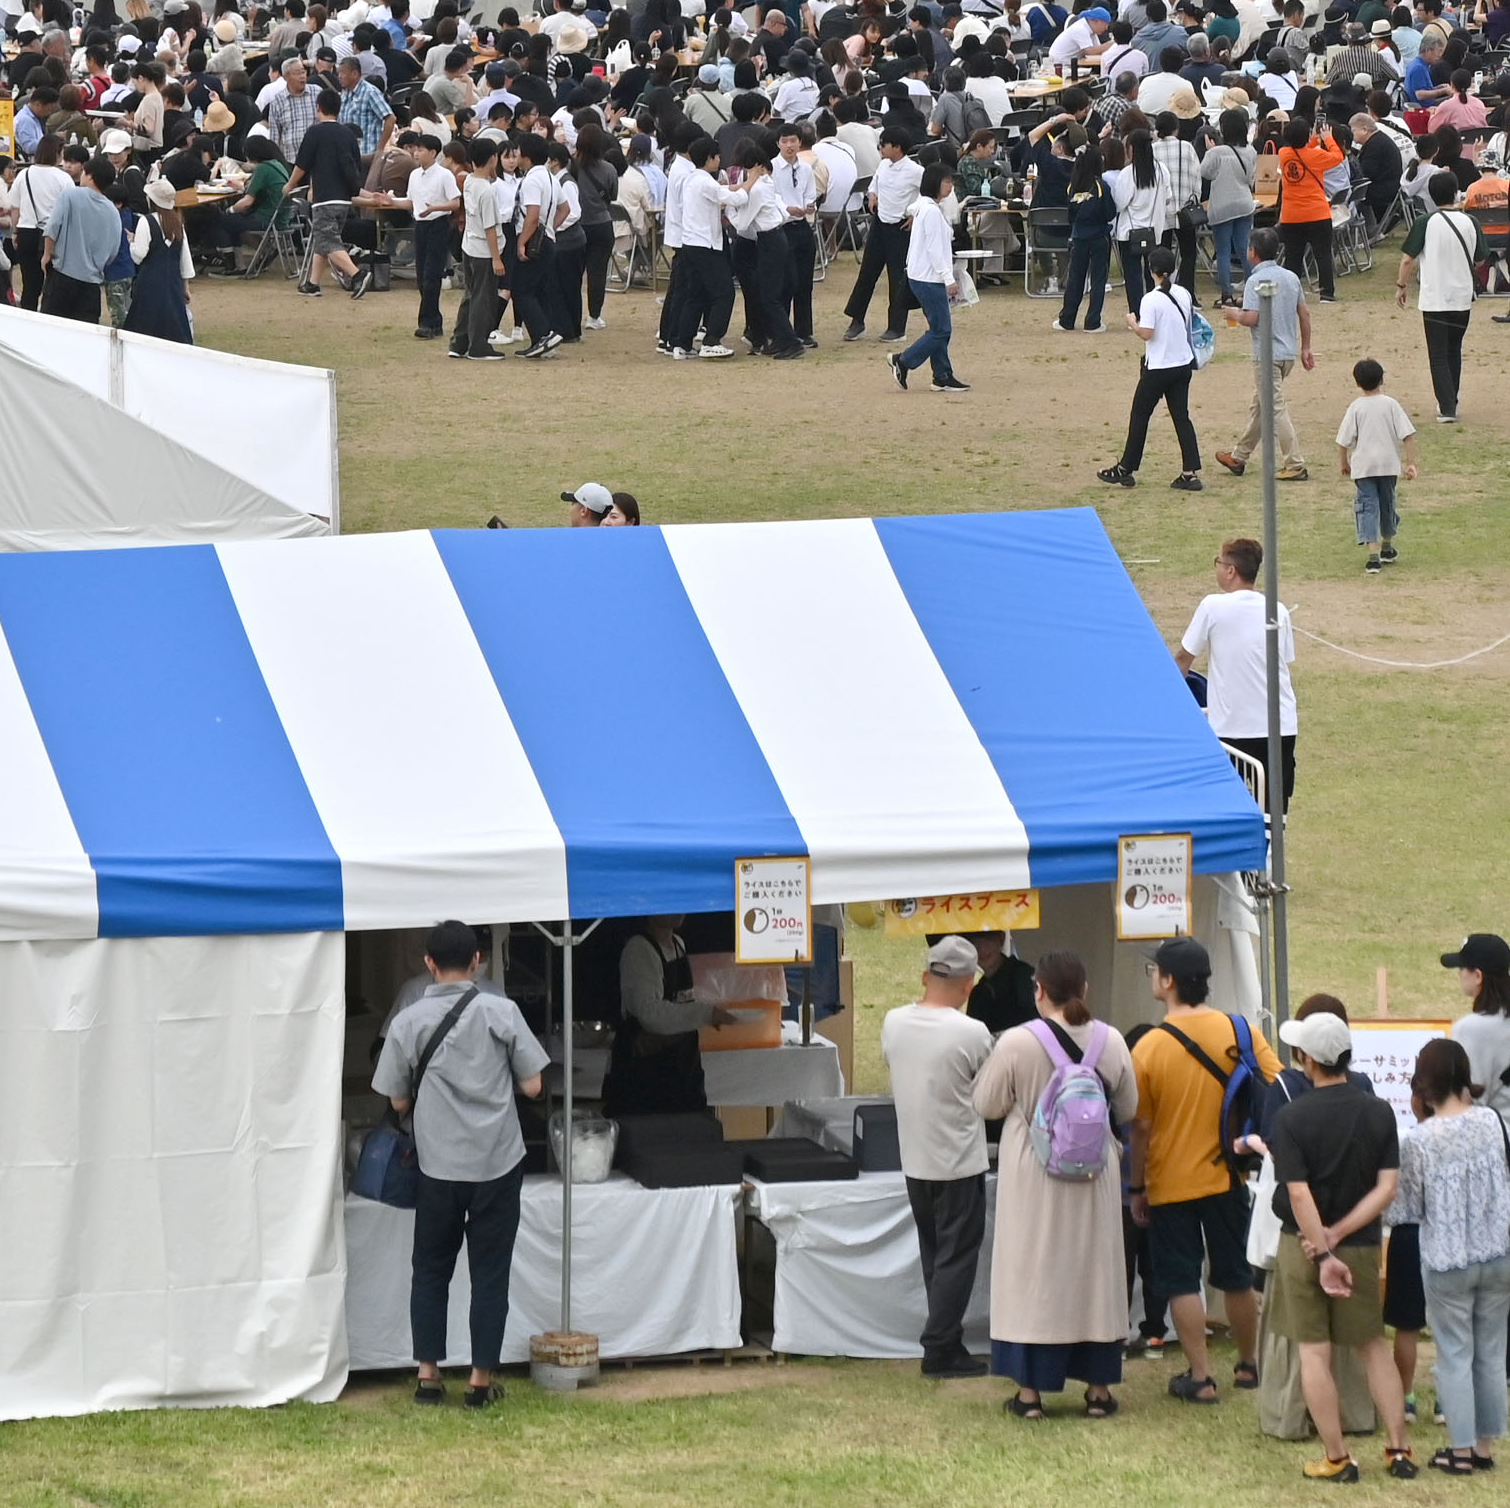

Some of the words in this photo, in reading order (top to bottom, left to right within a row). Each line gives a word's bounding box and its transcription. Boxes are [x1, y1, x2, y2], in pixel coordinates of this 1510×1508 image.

[744, 879, 802, 888] ライスはこちらで
